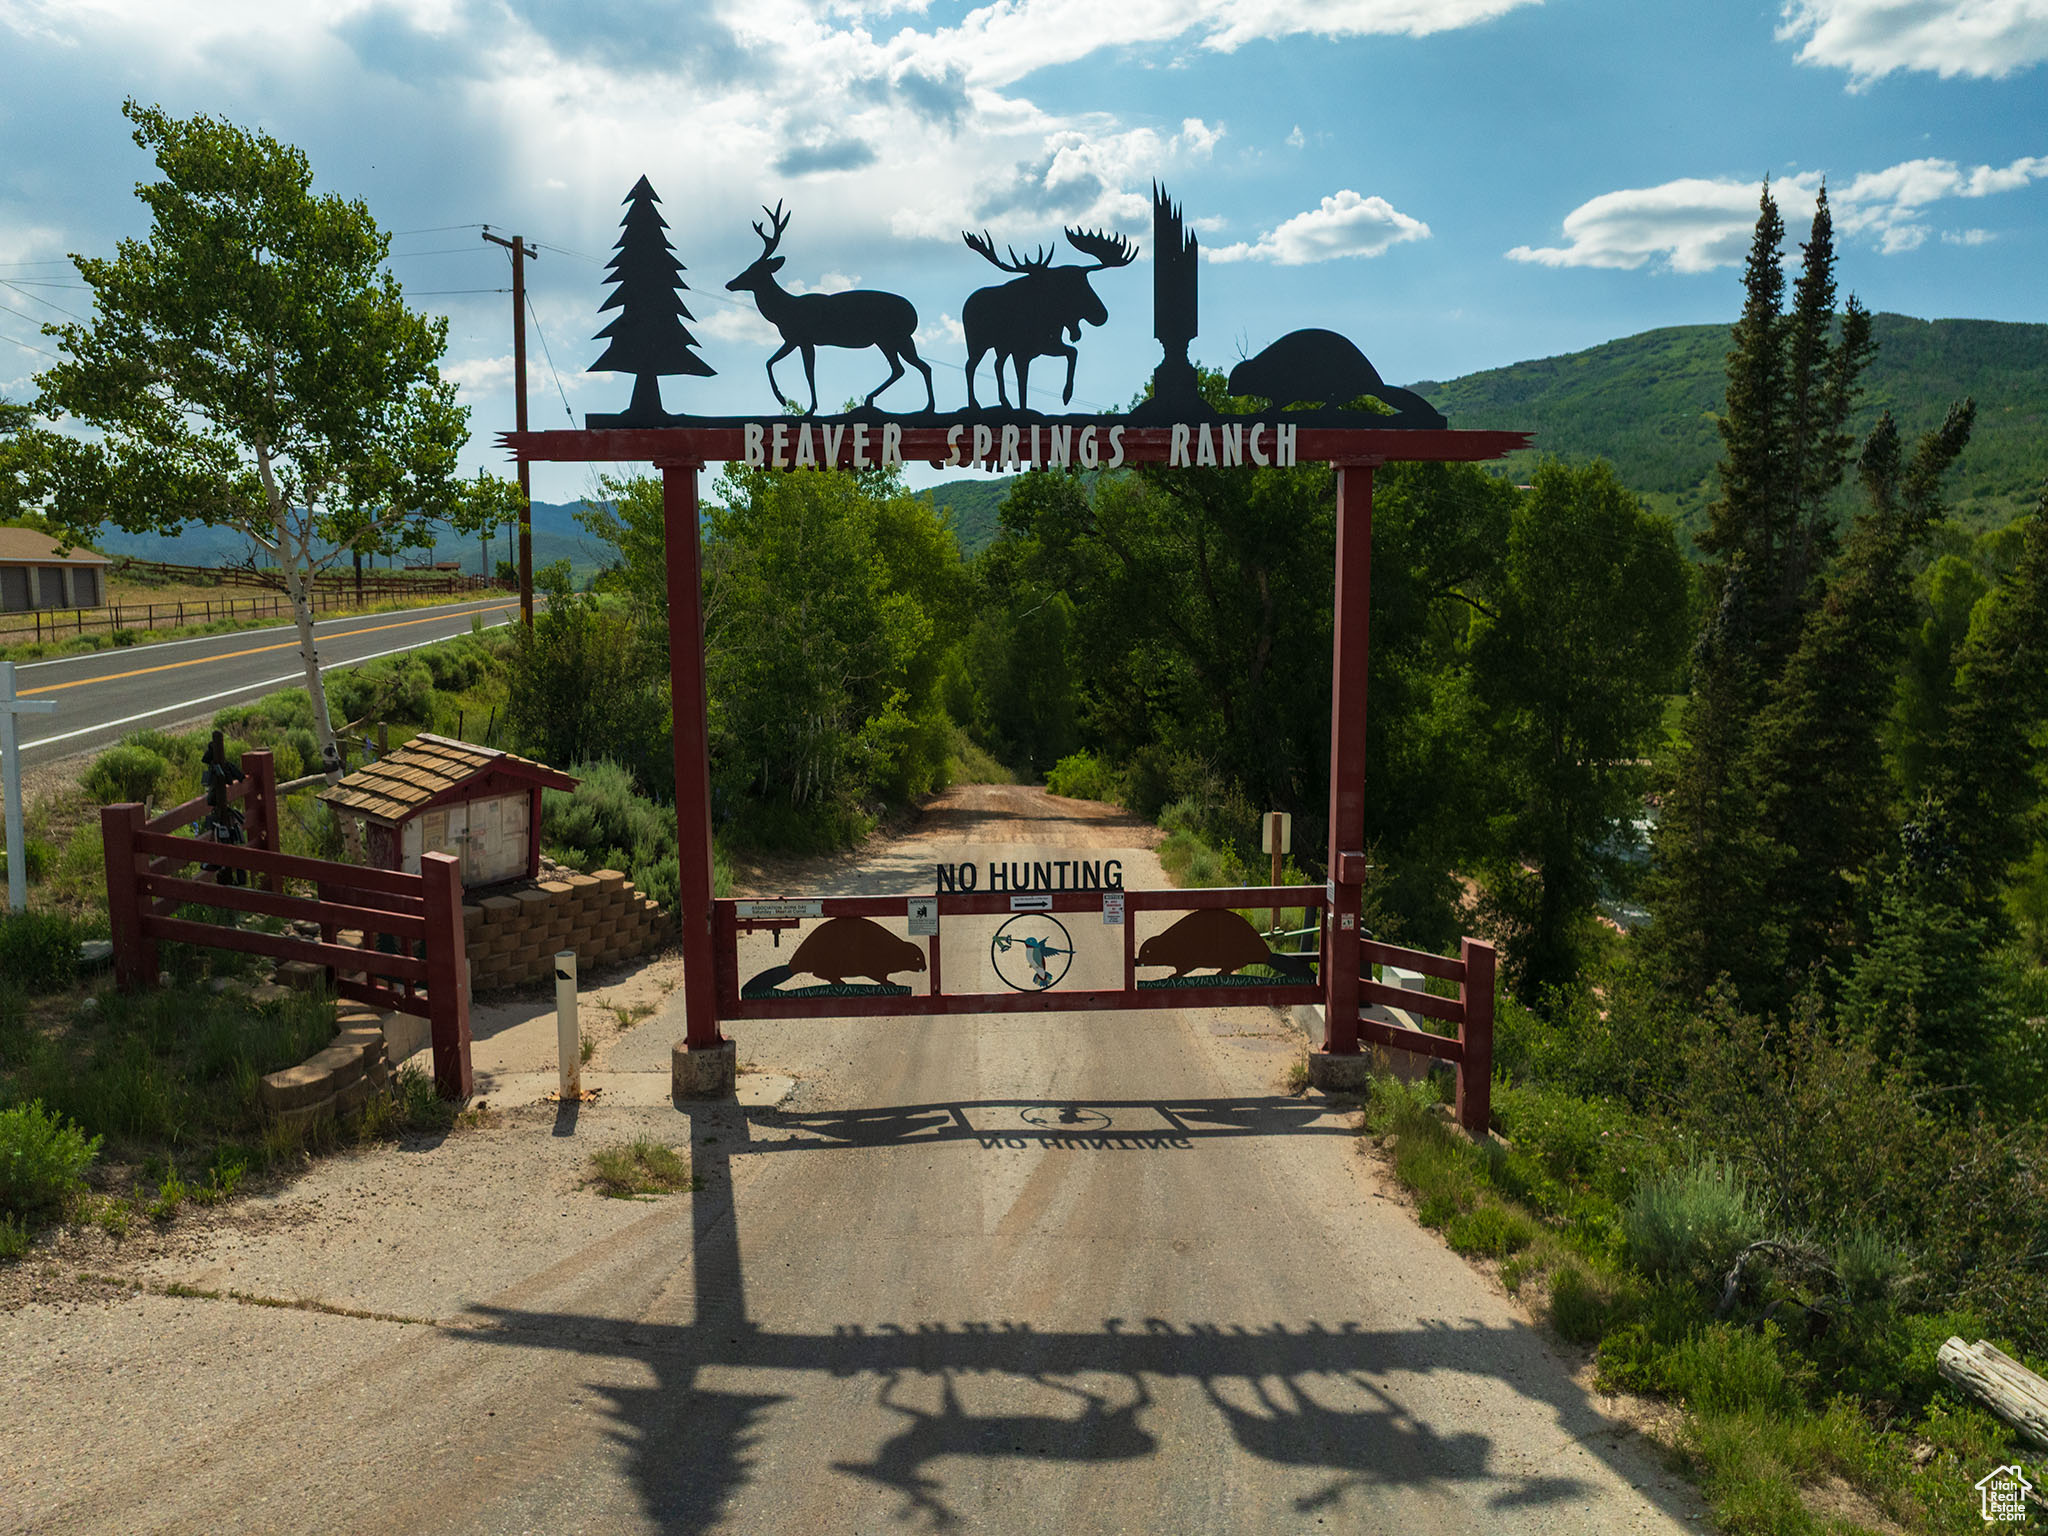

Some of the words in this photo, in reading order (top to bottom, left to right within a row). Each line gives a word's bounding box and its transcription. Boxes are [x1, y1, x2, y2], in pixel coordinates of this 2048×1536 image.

[744, 422, 902, 468] BEAVER
[945, 424, 1125, 471] SPRINGS
[1170, 422, 1297, 468] RANCH
[937, 863, 977, 892] NO
[990, 860, 1122, 890] HUNTING
